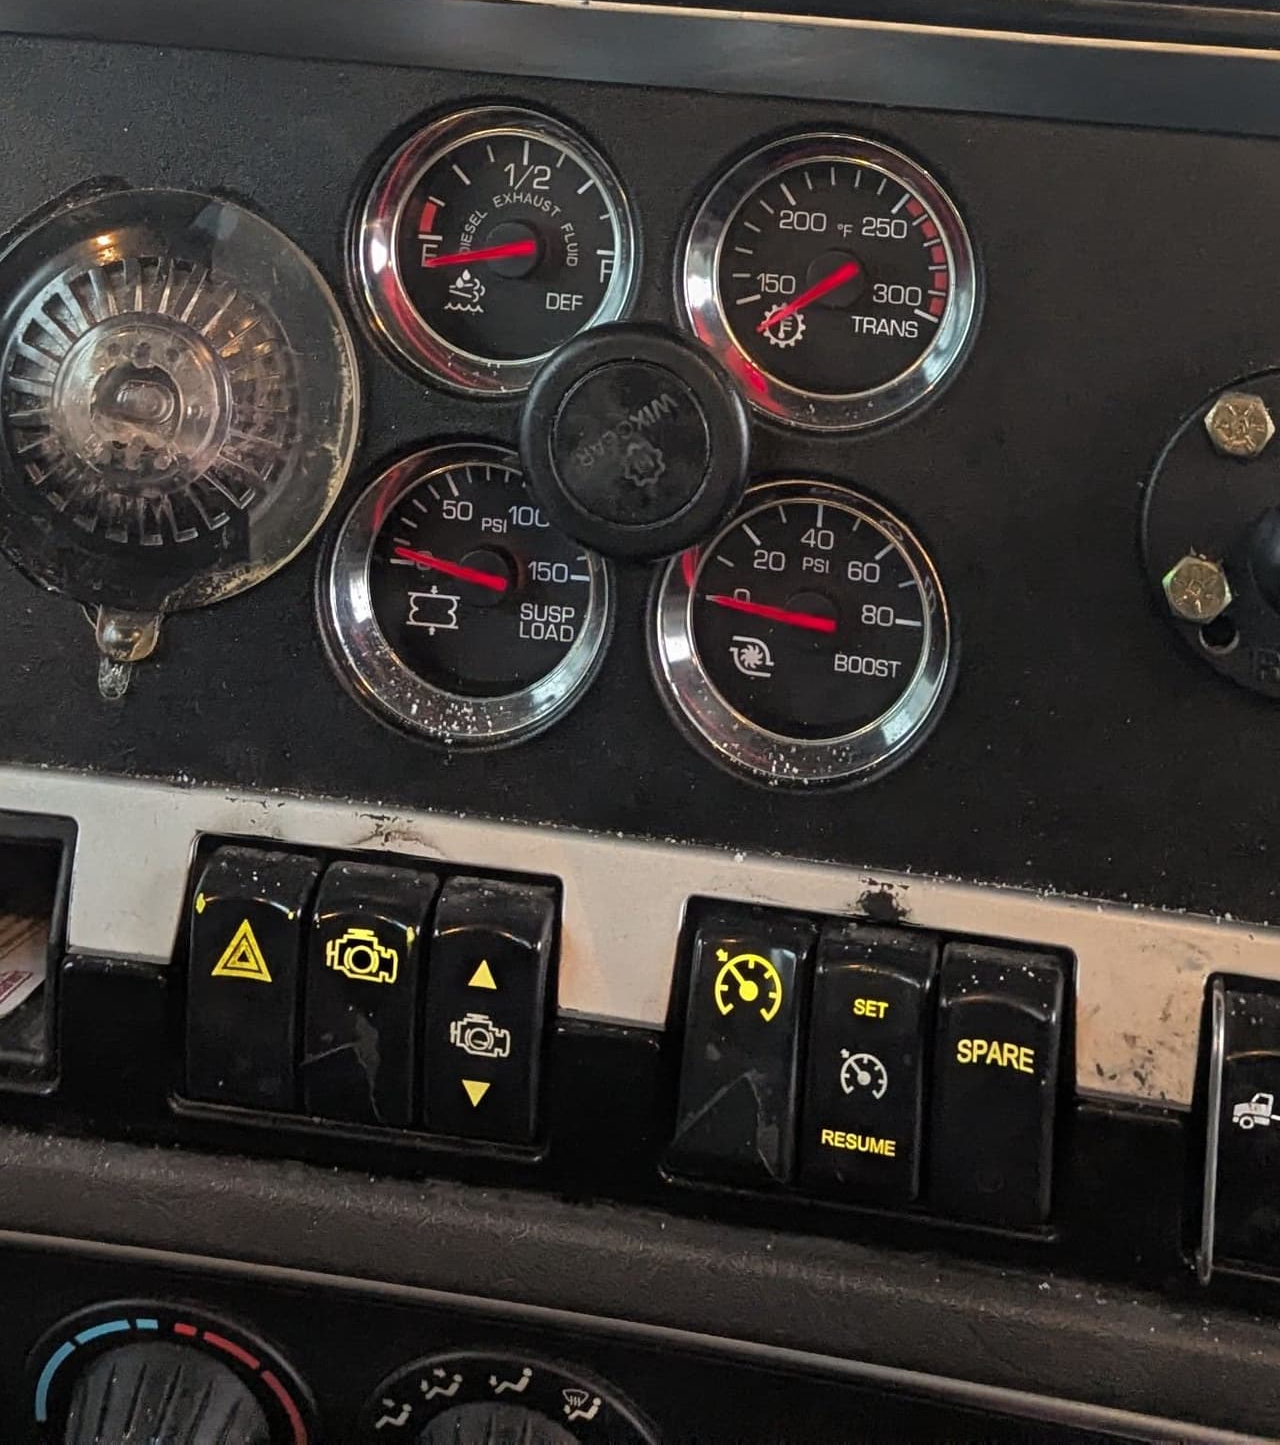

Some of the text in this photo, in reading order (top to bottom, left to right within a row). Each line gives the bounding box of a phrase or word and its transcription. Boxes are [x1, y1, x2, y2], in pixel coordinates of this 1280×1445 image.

[503, 162, 552, 191] 1/2
[492, 191, 562, 217] EXHAUST
[458, 209, 488, 255] DIESEL
[778, 210, 827, 232] 200
[861, 217, 908, 239] 250
[560, 222, 579, 267] FLUID
[599, 260, 616, 284] F
[756, 272, 796, 294] 150
[545, 292, 584, 311] DEF
[872, 283, 923, 306] 300
[850, 315, 919, 339] TRANS
[442, 500, 473, 522] 50
[481, 518, 508, 534] PSI
[800, 529, 835, 550] 40
[753, 549, 786, 571] 20
[802, 557, 830, 573] PSI
[528, 561, 569, 583] 150
[847, 561, 880, 583] 60
[520, 603, 575, 623] SUSP
[861, 604, 894, 627] 80
[519, 622, 574, 642] LOAD
[834, 654, 902, 678] BOOST
[853, 998, 889, 1019] SET
[956, 1039, 1035, 1073] SPARE
[821, 1129, 896, 1157] RESUME
